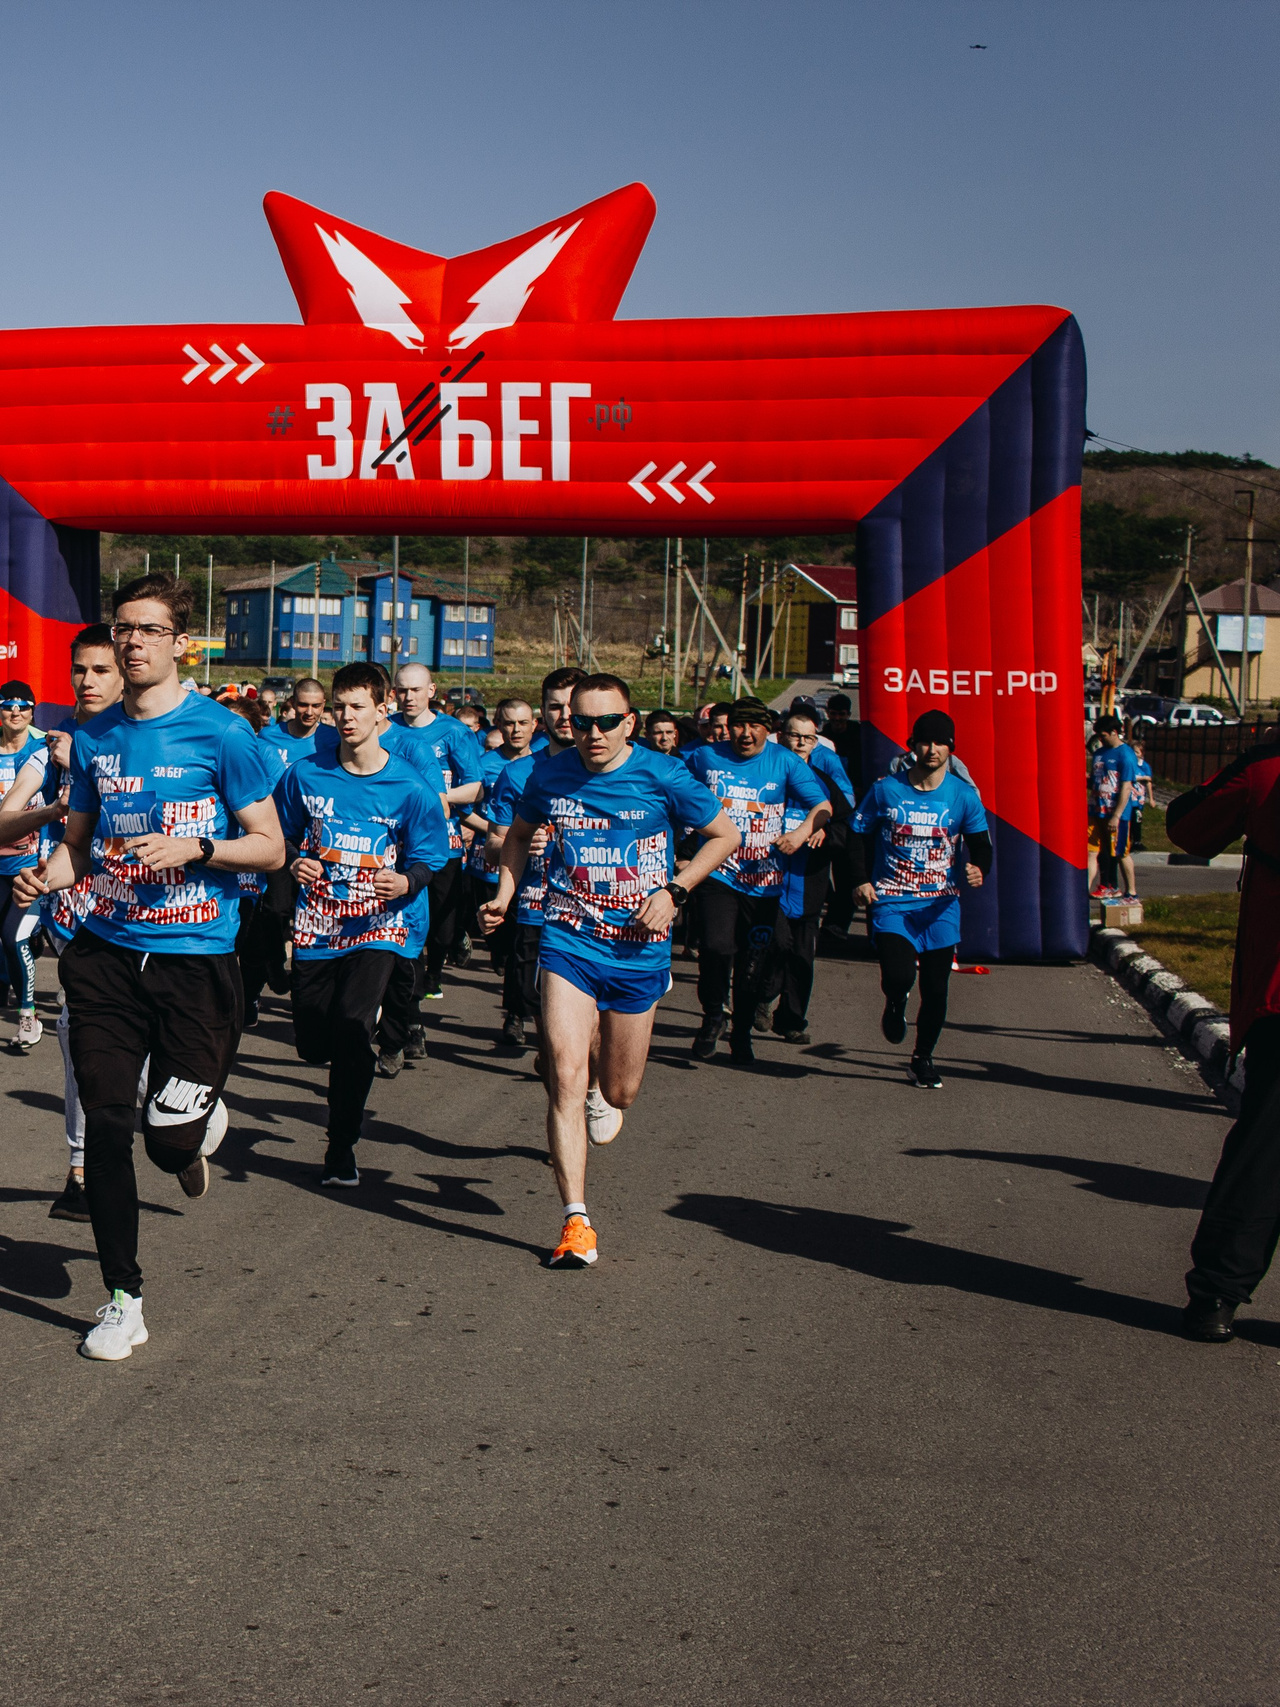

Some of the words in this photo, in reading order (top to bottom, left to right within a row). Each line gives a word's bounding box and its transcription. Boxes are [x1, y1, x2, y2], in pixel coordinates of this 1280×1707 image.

[883, 667, 1057, 696] ЗАБЕГ.РФ
[727, 785, 757, 800] 20033
[550, 798, 586, 817] 2024
[112, 812, 149, 834] 20007
[908, 811, 938, 826] 30012
[334, 832, 372, 852] 20018
[580, 847, 623, 865] 30014
[586, 866, 617, 882] 10KM
[164, 880, 208, 908] 2024
[156, 1076, 213, 1113] NIKE
